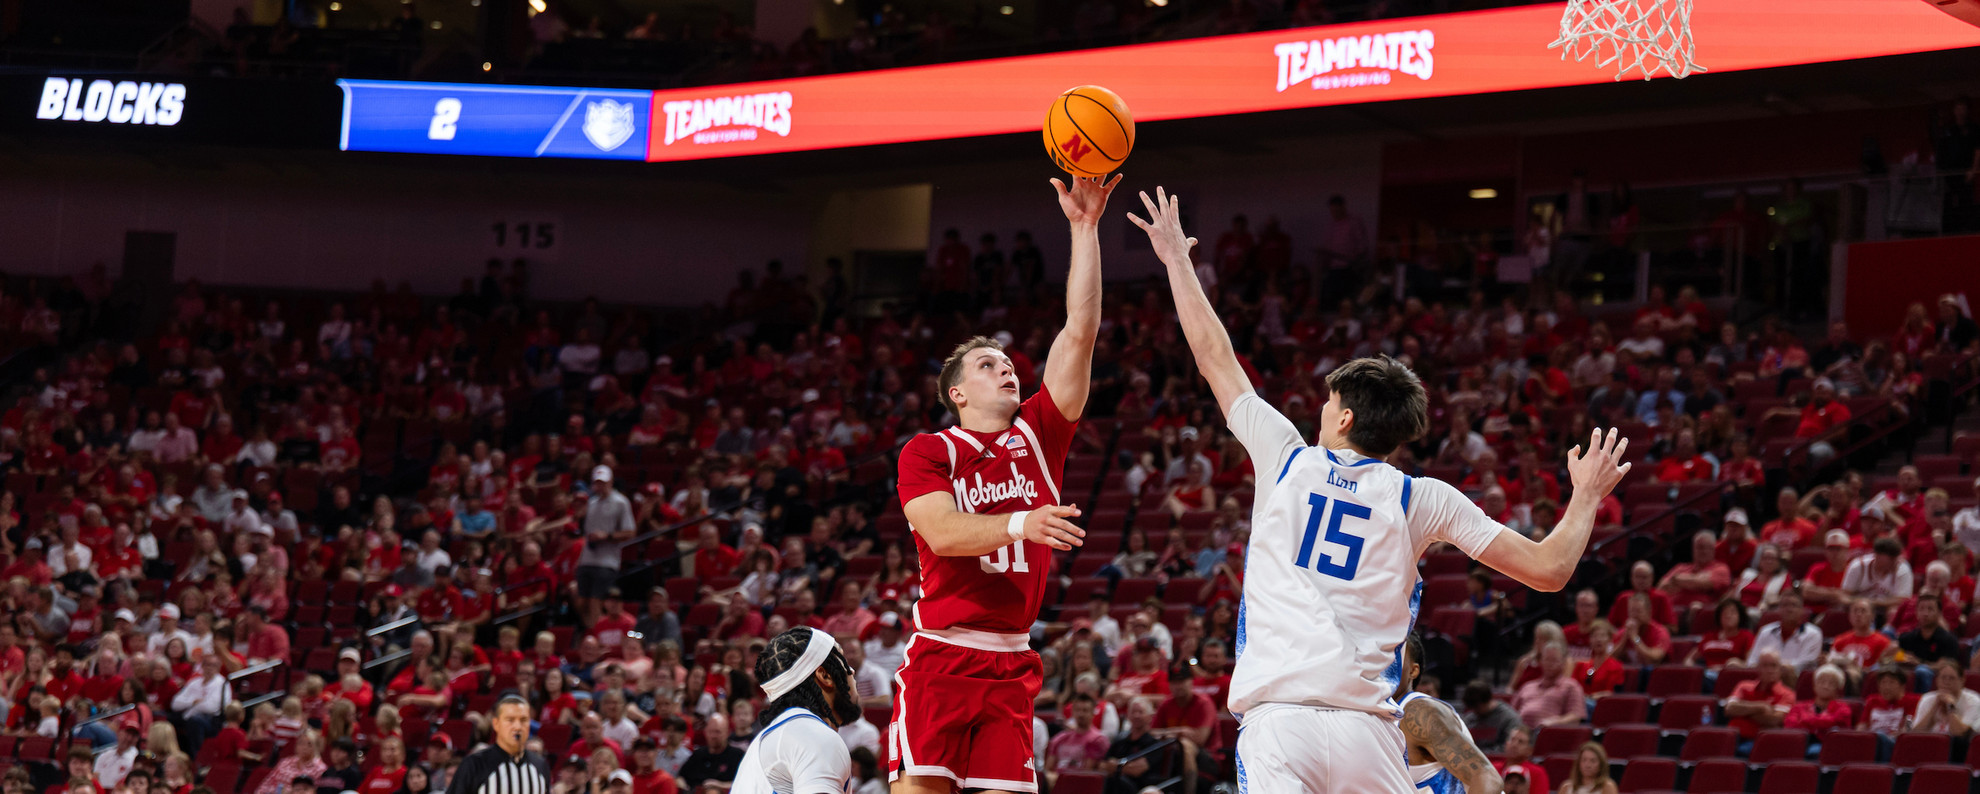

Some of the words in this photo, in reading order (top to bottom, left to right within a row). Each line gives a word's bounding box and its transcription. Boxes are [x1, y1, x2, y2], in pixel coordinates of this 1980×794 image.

[1274, 29, 1435, 93] TEAMMATES
[36, 76, 187, 126] BLOCKS
[428, 97, 463, 140] 2
[663, 91, 793, 146] TEAMMATES
[1061, 131, 1092, 163] N
[492, 221, 555, 249] 115
[952, 461, 1038, 514] Nebraska
[1294, 491, 1372, 582] 15
